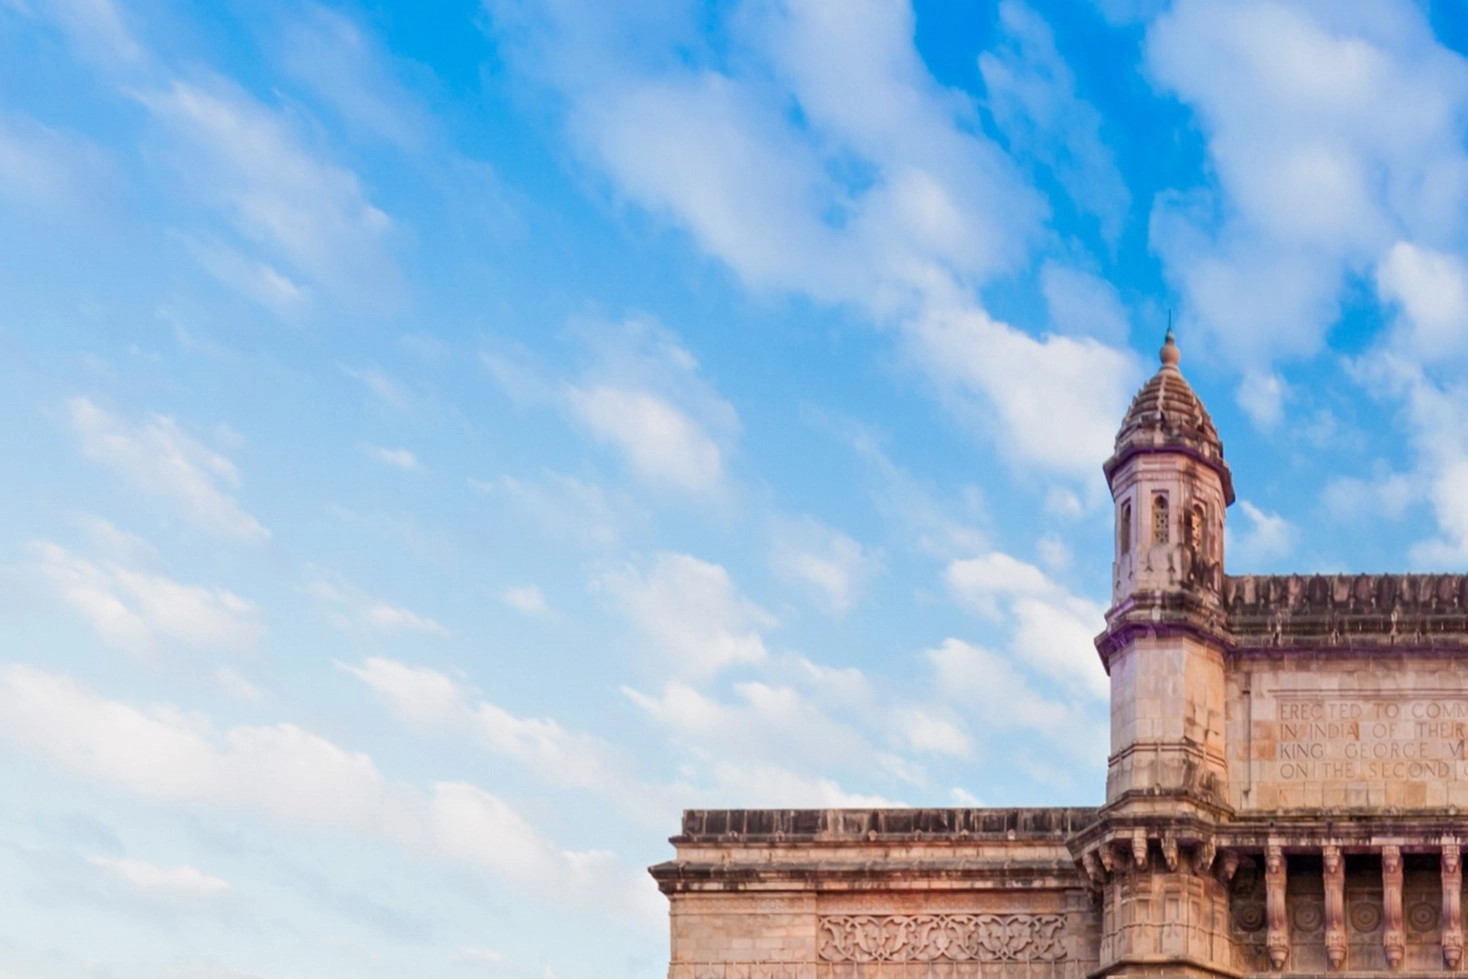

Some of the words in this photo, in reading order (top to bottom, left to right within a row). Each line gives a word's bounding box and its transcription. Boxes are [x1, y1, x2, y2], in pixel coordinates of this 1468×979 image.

[1280, 703, 1362, 719] ERECTED
[1374, 703, 1399, 719] TO
[1280, 723, 1298, 740] IN
[1309, 722, 1359, 740] INDIA
[1372, 723, 1396, 739] OF
[1416, 722, 1465, 739] THEIR
[1280, 742, 1324, 760] KING
[1345, 742, 1428, 759] GEORGE
[1448, 742, 1463, 757] V
[1280, 763, 1308, 780] ON
[1324, 762, 1353, 778] THE
[1369, 762, 1450, 778] SECOND
